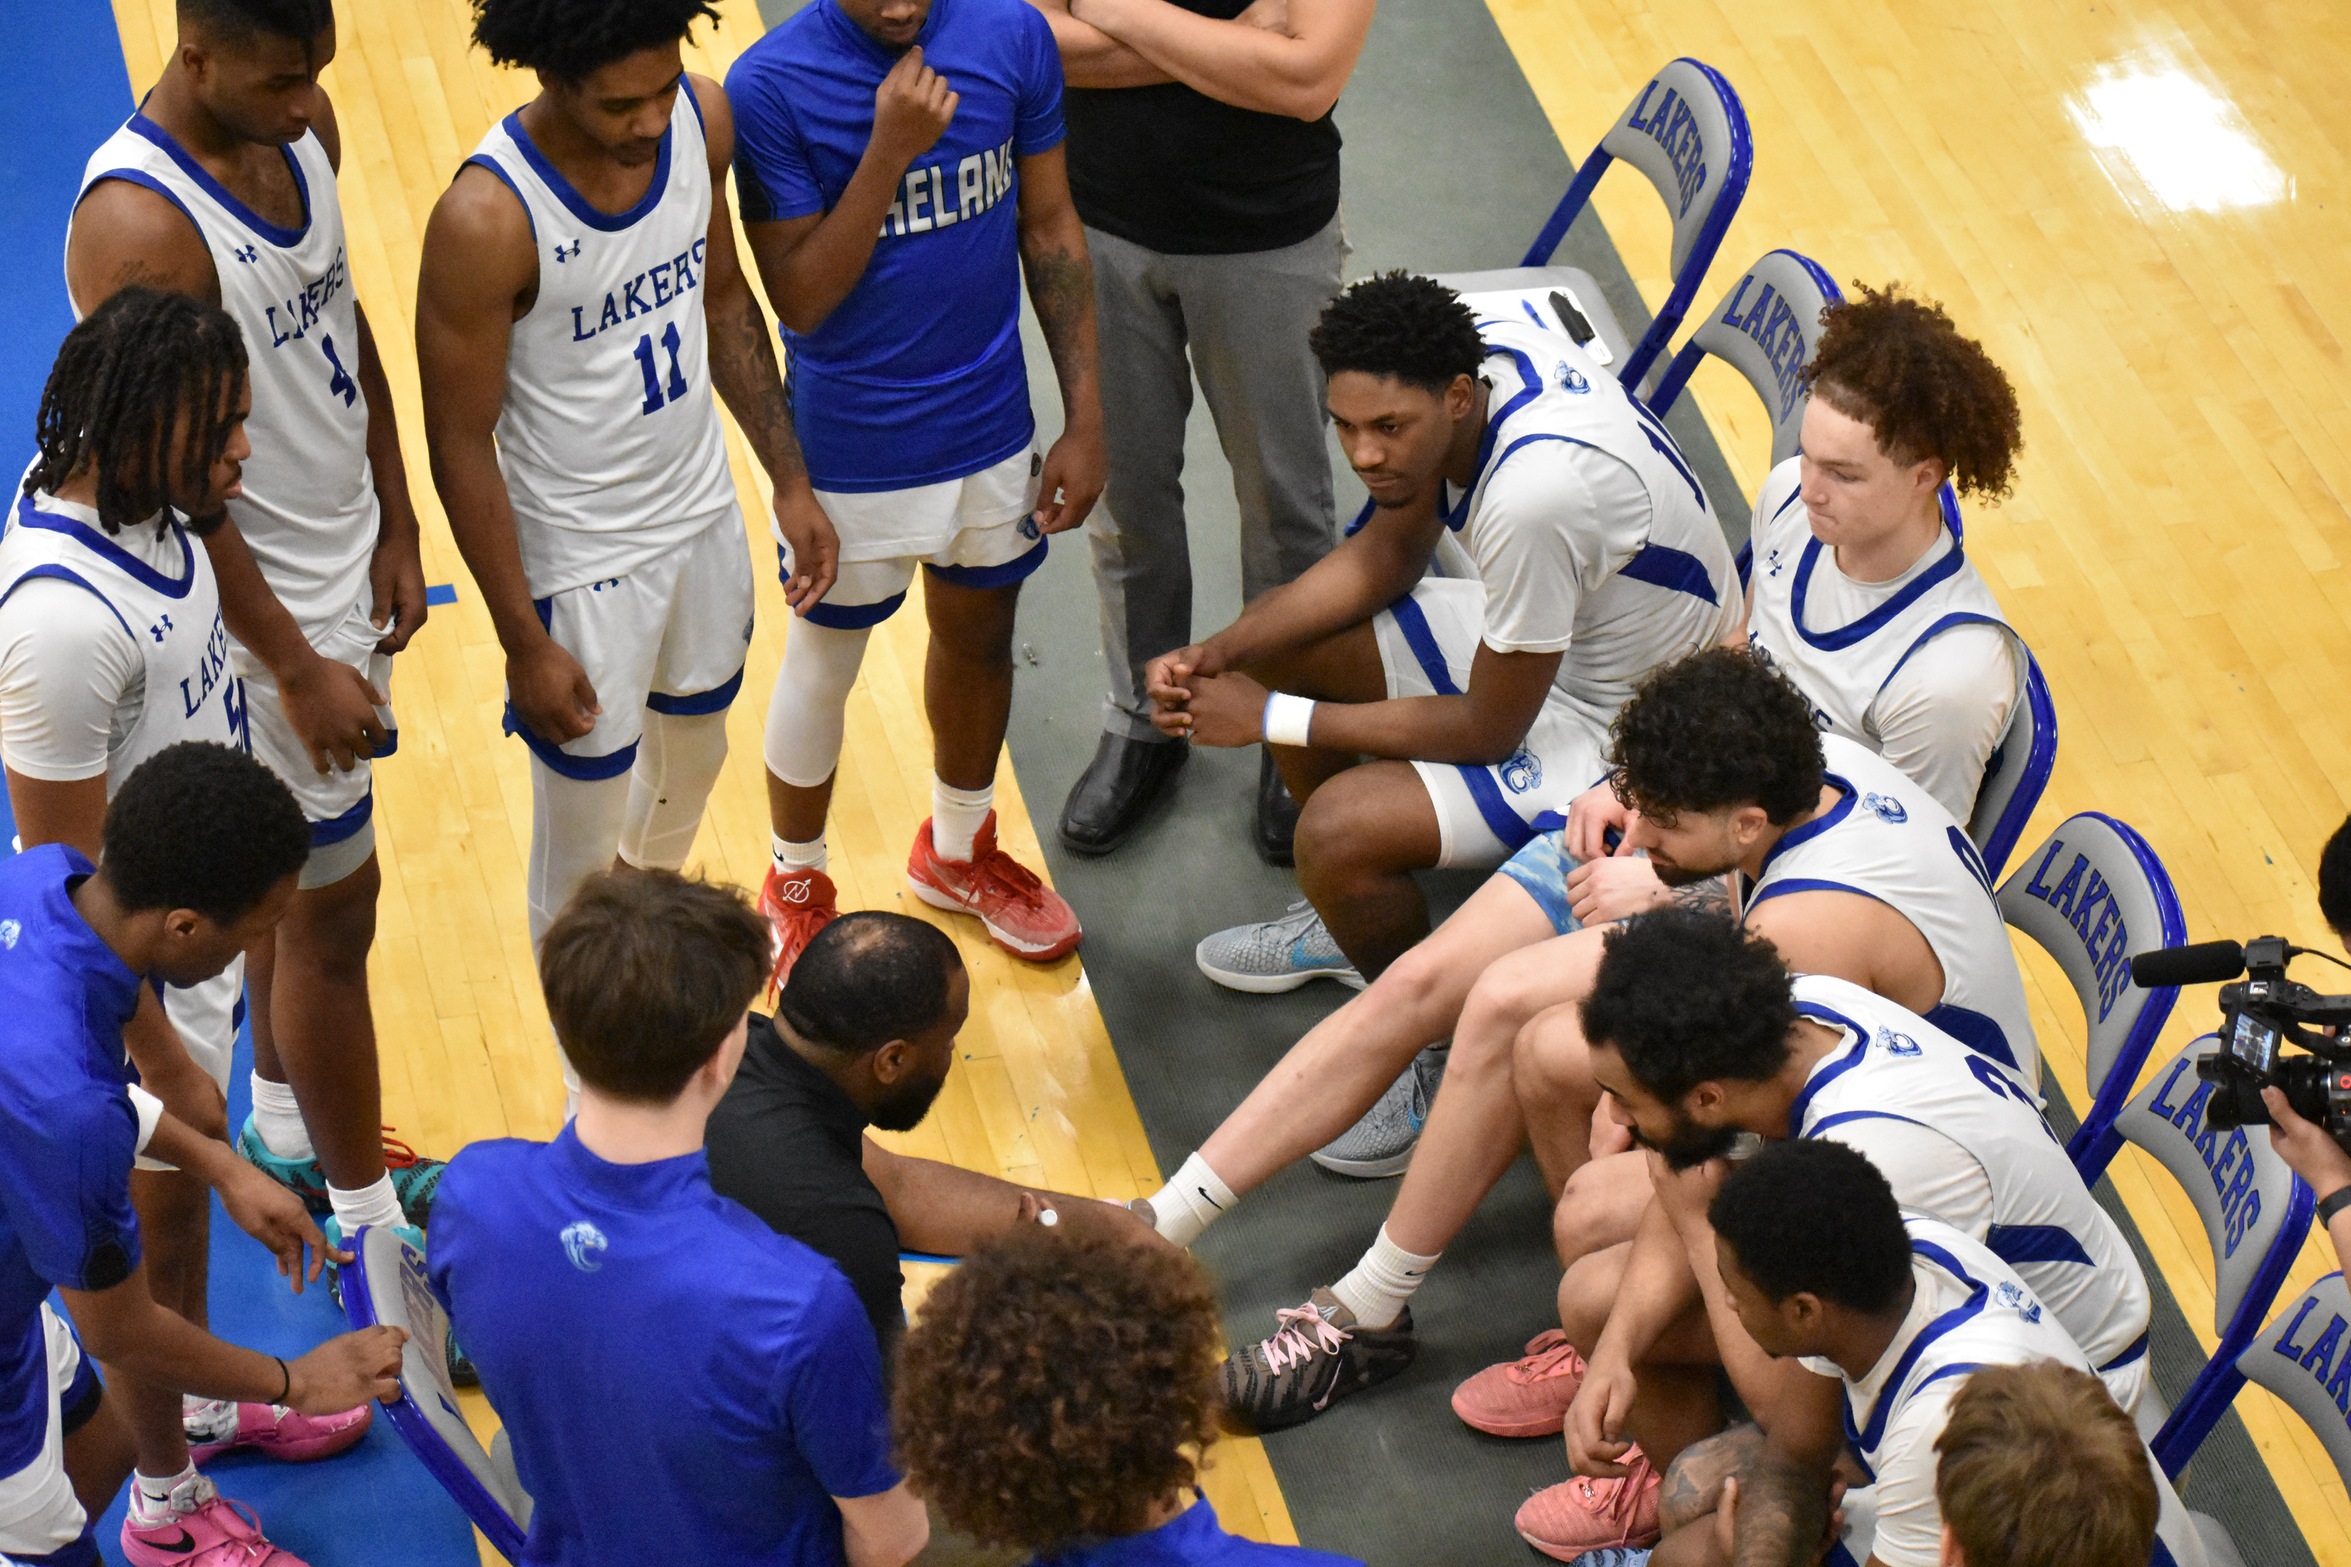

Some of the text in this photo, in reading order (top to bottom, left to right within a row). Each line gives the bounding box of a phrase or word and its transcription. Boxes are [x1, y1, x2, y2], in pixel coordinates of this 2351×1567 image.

[1627, 79, 1707, 220] LAKERS
[321, 332, 357, 409] 4
[633, 321, 688, 416] 11
[1721, 275, 1812, 426] LAKERS
[180, 602, 229, 719] LAKE
[2025, 840, 2132, 1025] LAKERS
[2273, 1296, 2351, 1433] LAK
